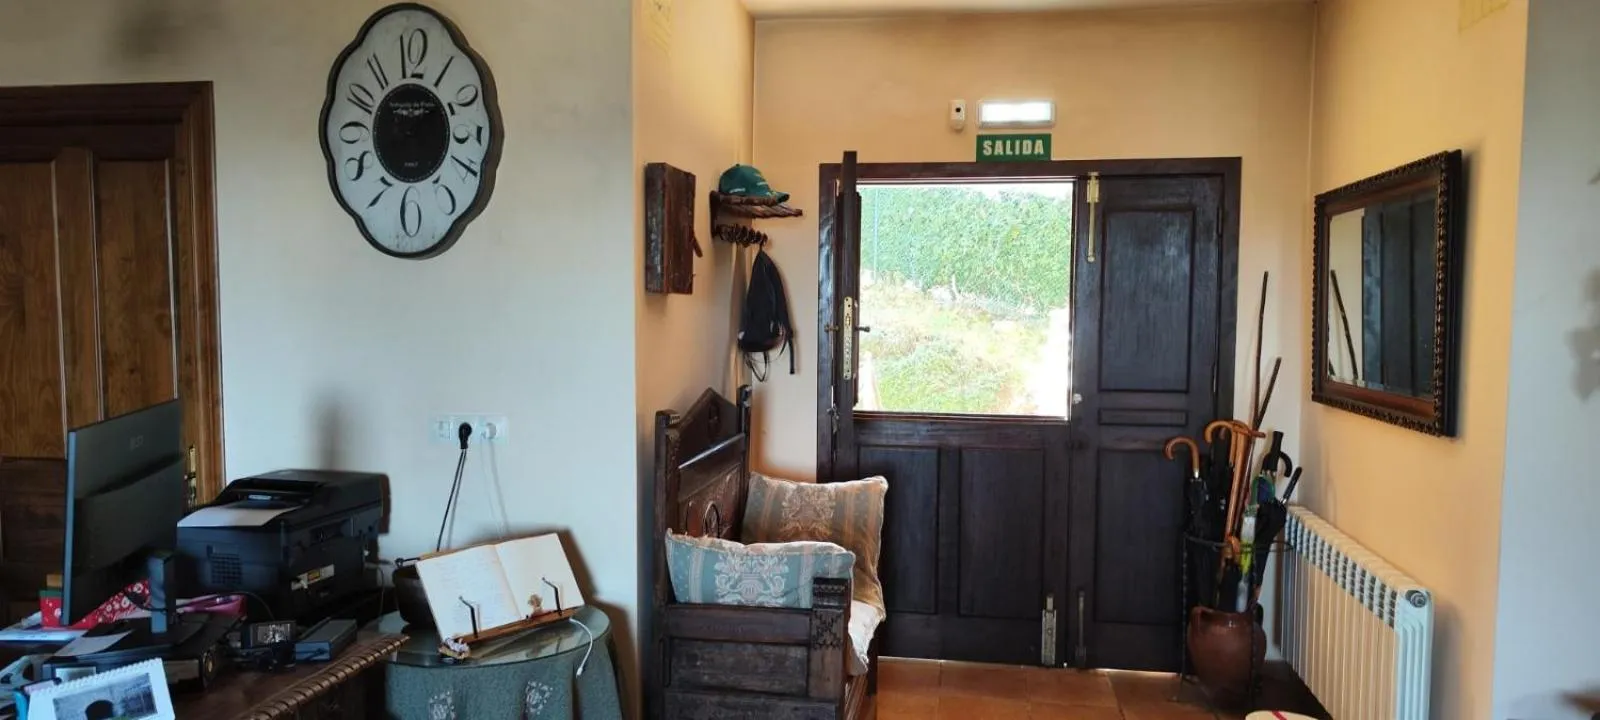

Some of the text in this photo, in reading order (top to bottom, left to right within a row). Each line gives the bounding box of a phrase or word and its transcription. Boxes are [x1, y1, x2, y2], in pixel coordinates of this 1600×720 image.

[399, 28, 428, 80] 12
[366, 53, 389, 90] 11
[433, 56, 455, 88] 1
[347, 83, 375, 115] 10
[447, 84, 479, 116] 2
[338, 121, 371, 145] 9
[452, 123, 484, 147] 3
[982, 138, 1045, 156] SALIDA
[343, 150, 374, 182] 8
[450, 154, 479, 185] 4
[365, 176, 394, 210] 7
[431, 175, 457, 216] 5
[399, 185, 423, 238] 6
